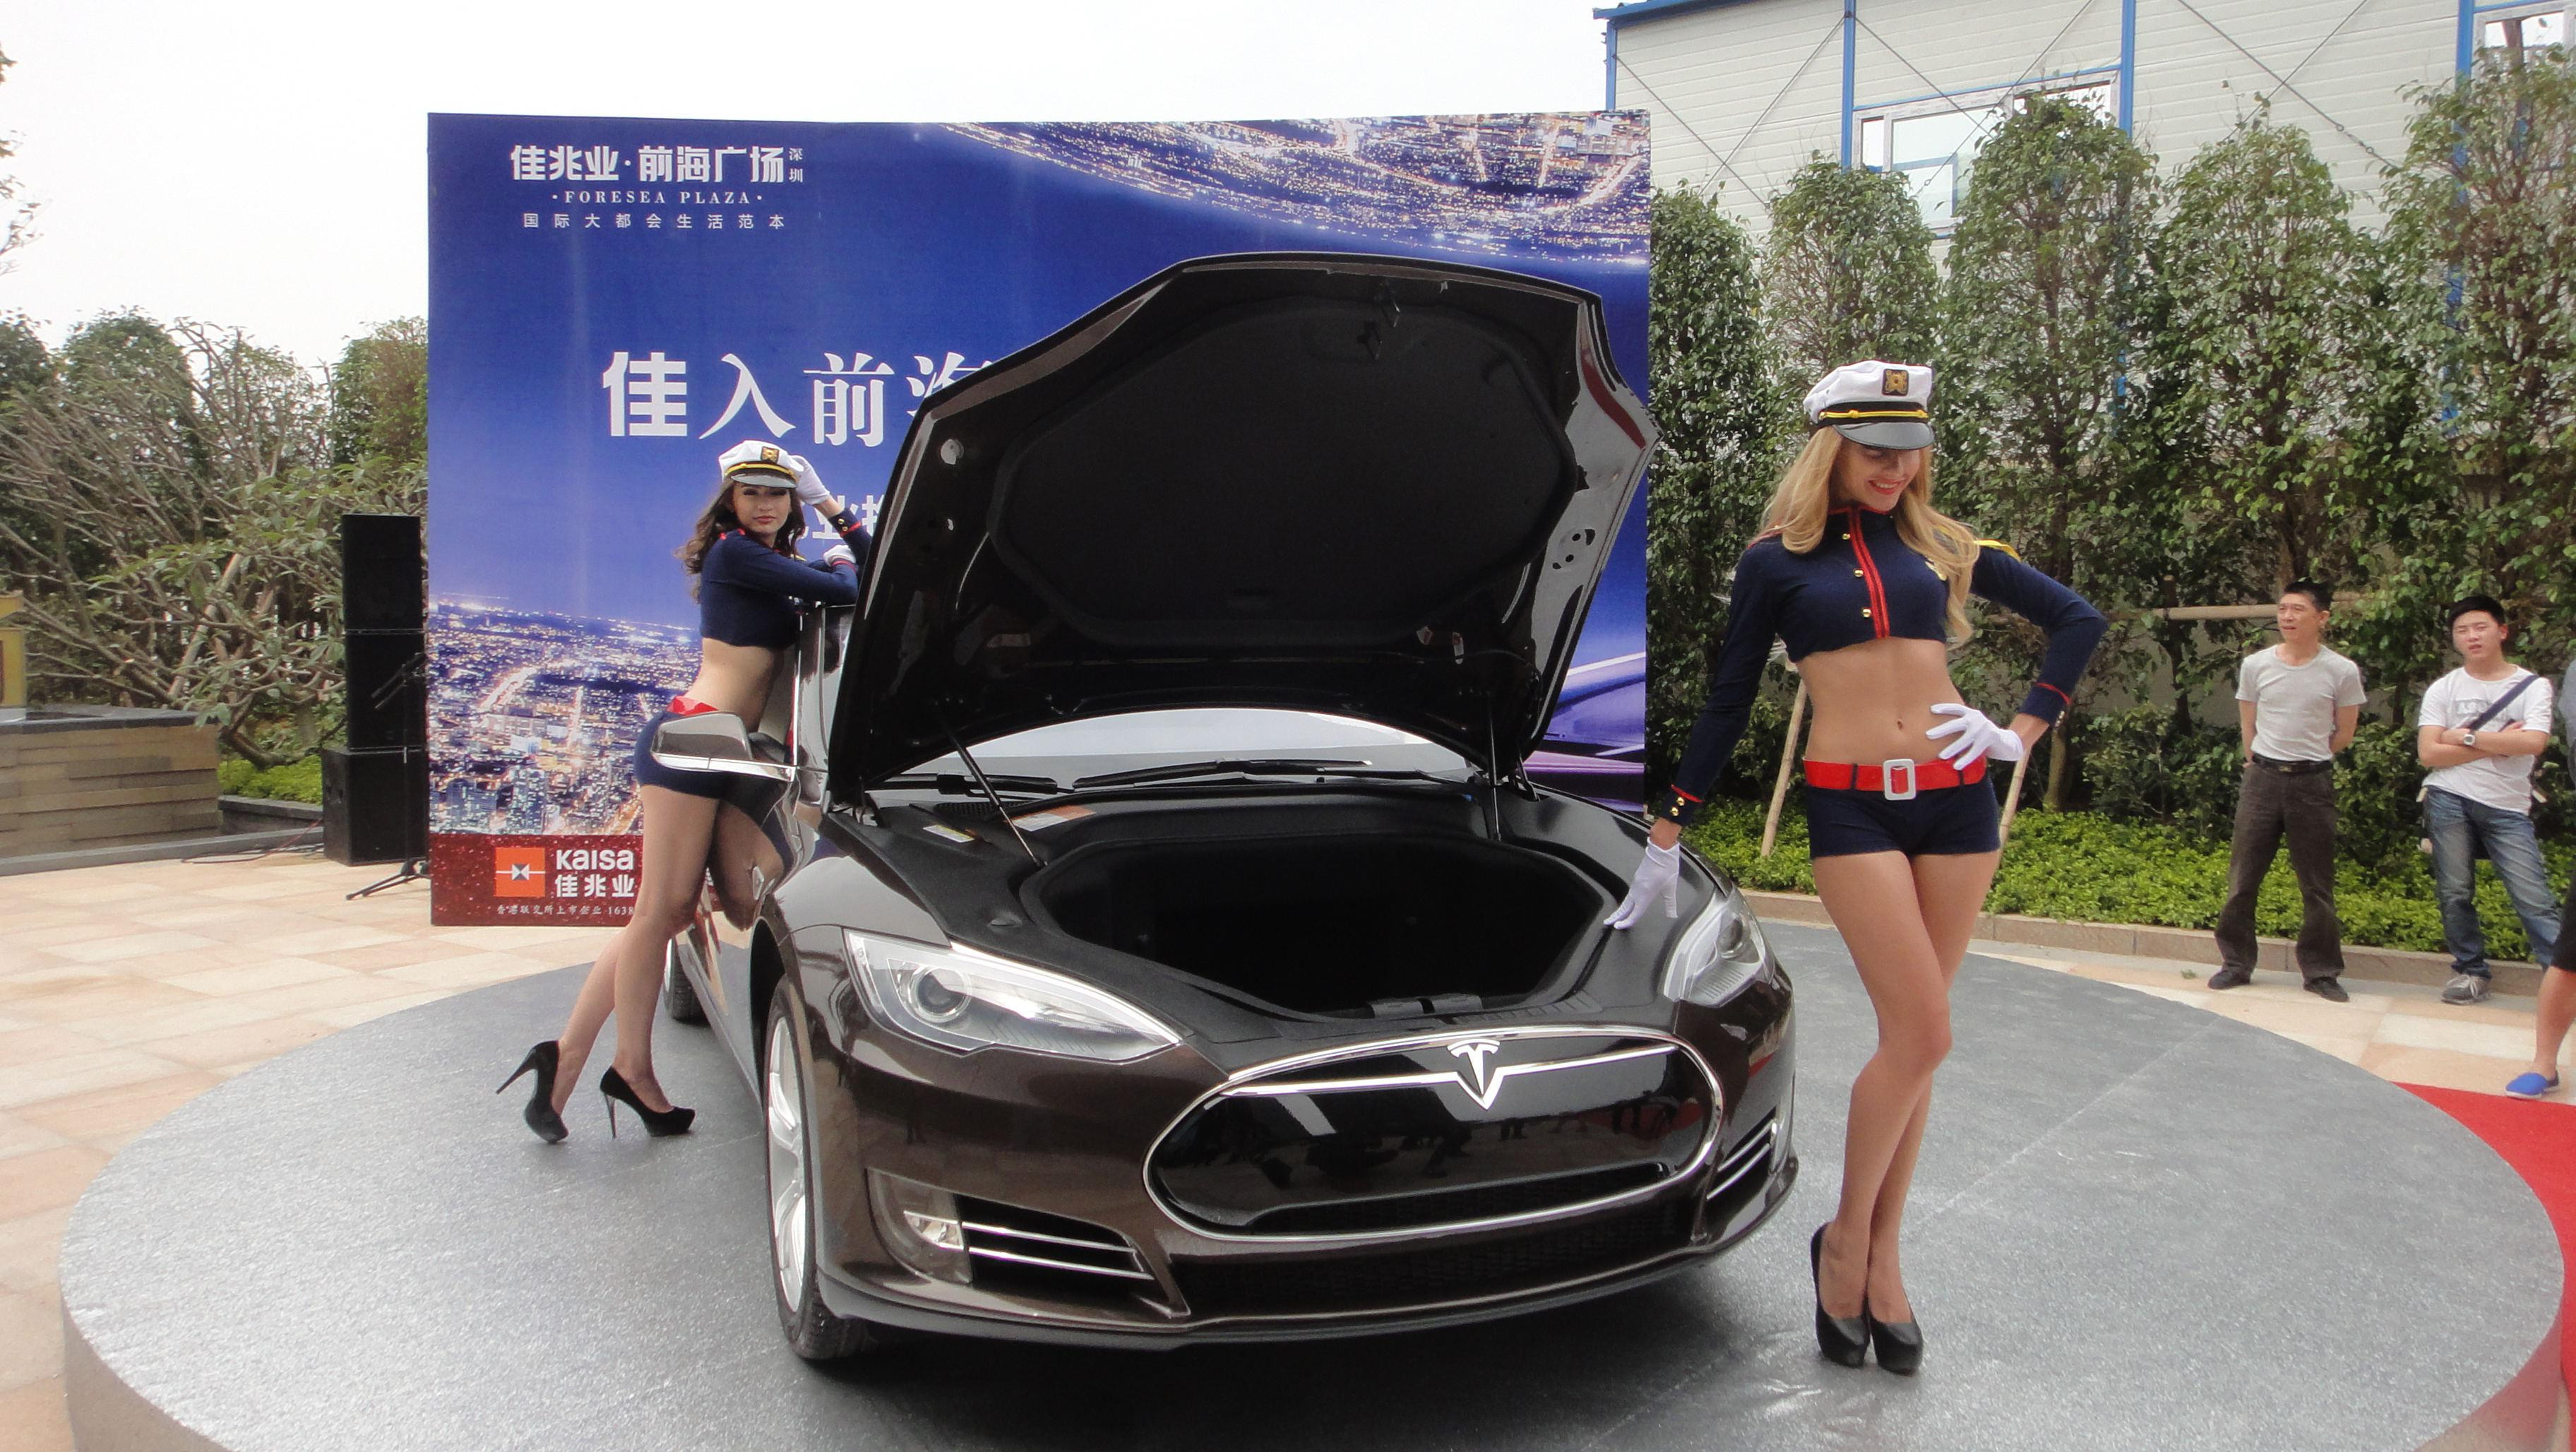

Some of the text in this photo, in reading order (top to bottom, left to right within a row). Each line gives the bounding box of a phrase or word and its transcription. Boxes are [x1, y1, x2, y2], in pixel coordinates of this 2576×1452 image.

[511, 145, 784, 183] 佳兆业·前海广场
[788, 147, 804, 183] 深圳
[523, 213, 785, 230] 国际大都会生活范本
[555, 874, 634, 898] 佳兆业
